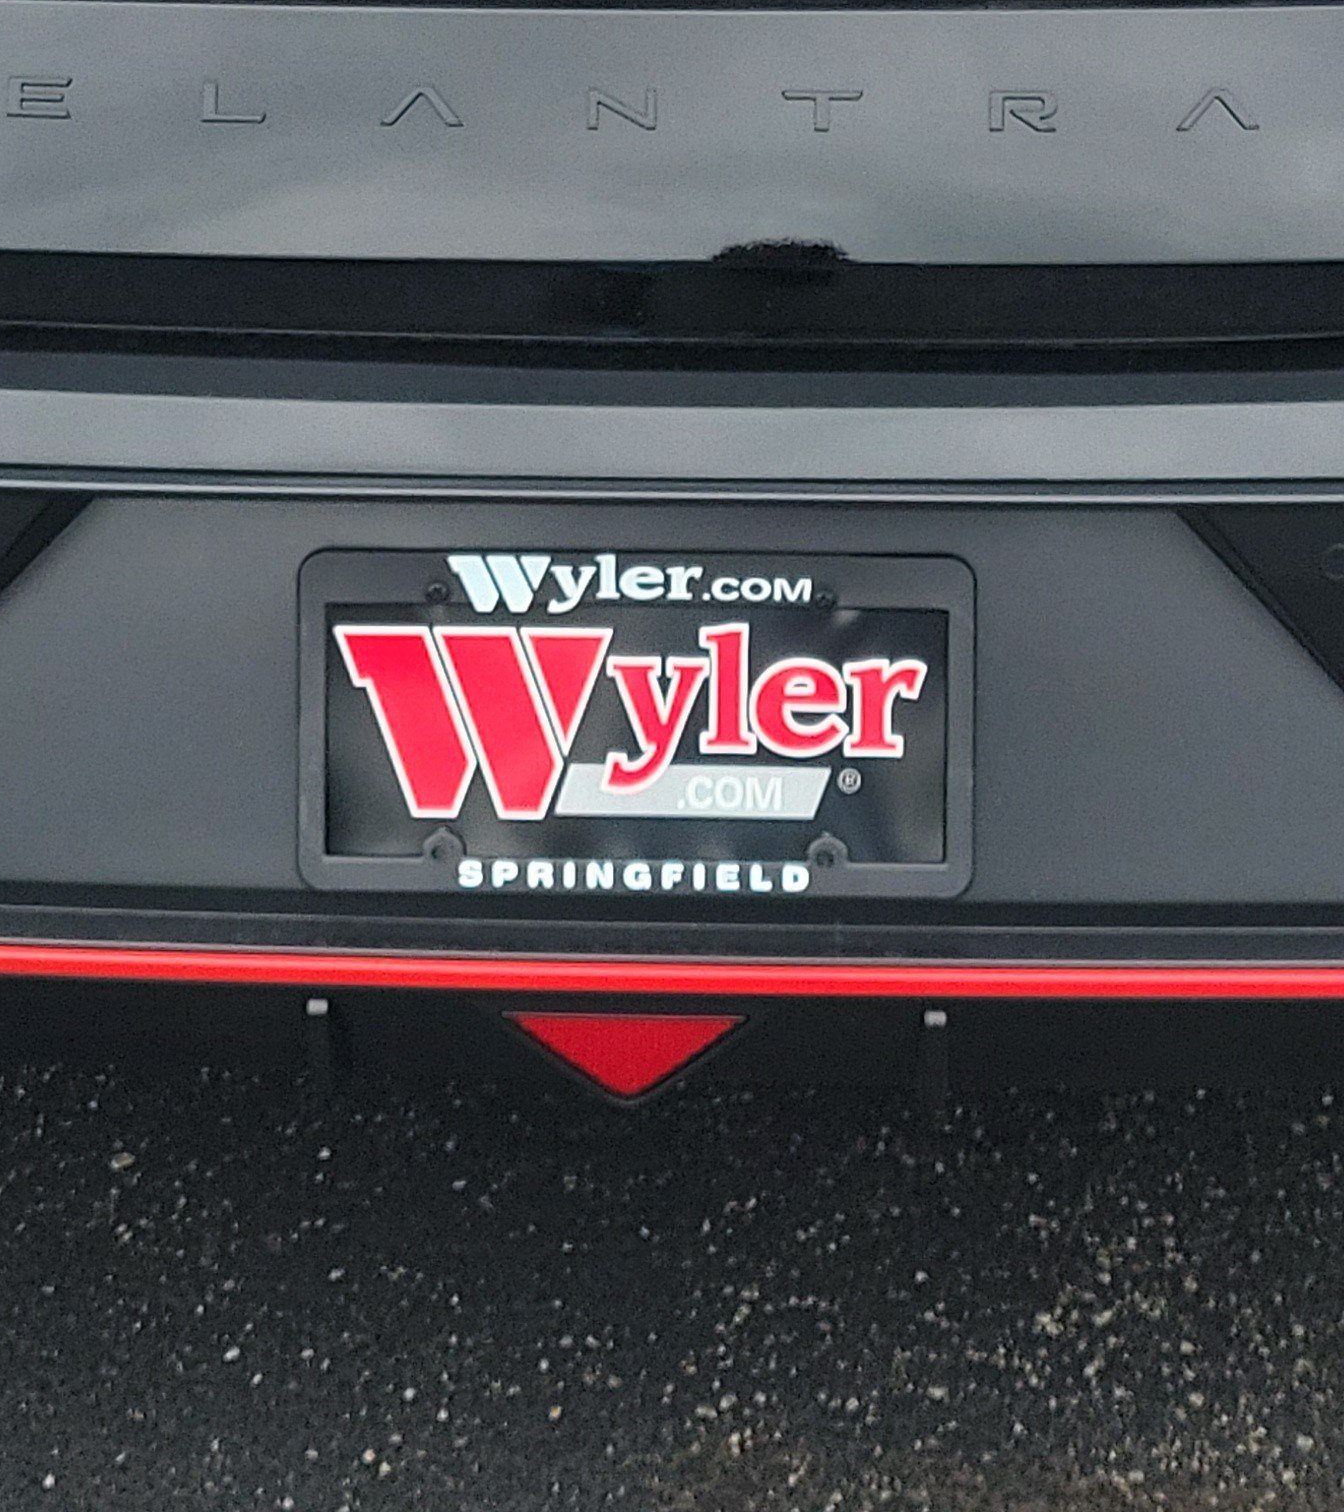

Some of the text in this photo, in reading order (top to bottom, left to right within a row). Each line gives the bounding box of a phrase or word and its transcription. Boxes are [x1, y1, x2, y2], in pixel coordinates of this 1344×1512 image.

[6, 75, 1261, 132] ELANTRA
[332, 622, 929, 821] Wyler
[675, 776, 784, 811] .COM
[458, 859, 811, 892] SPRINGFIELD
